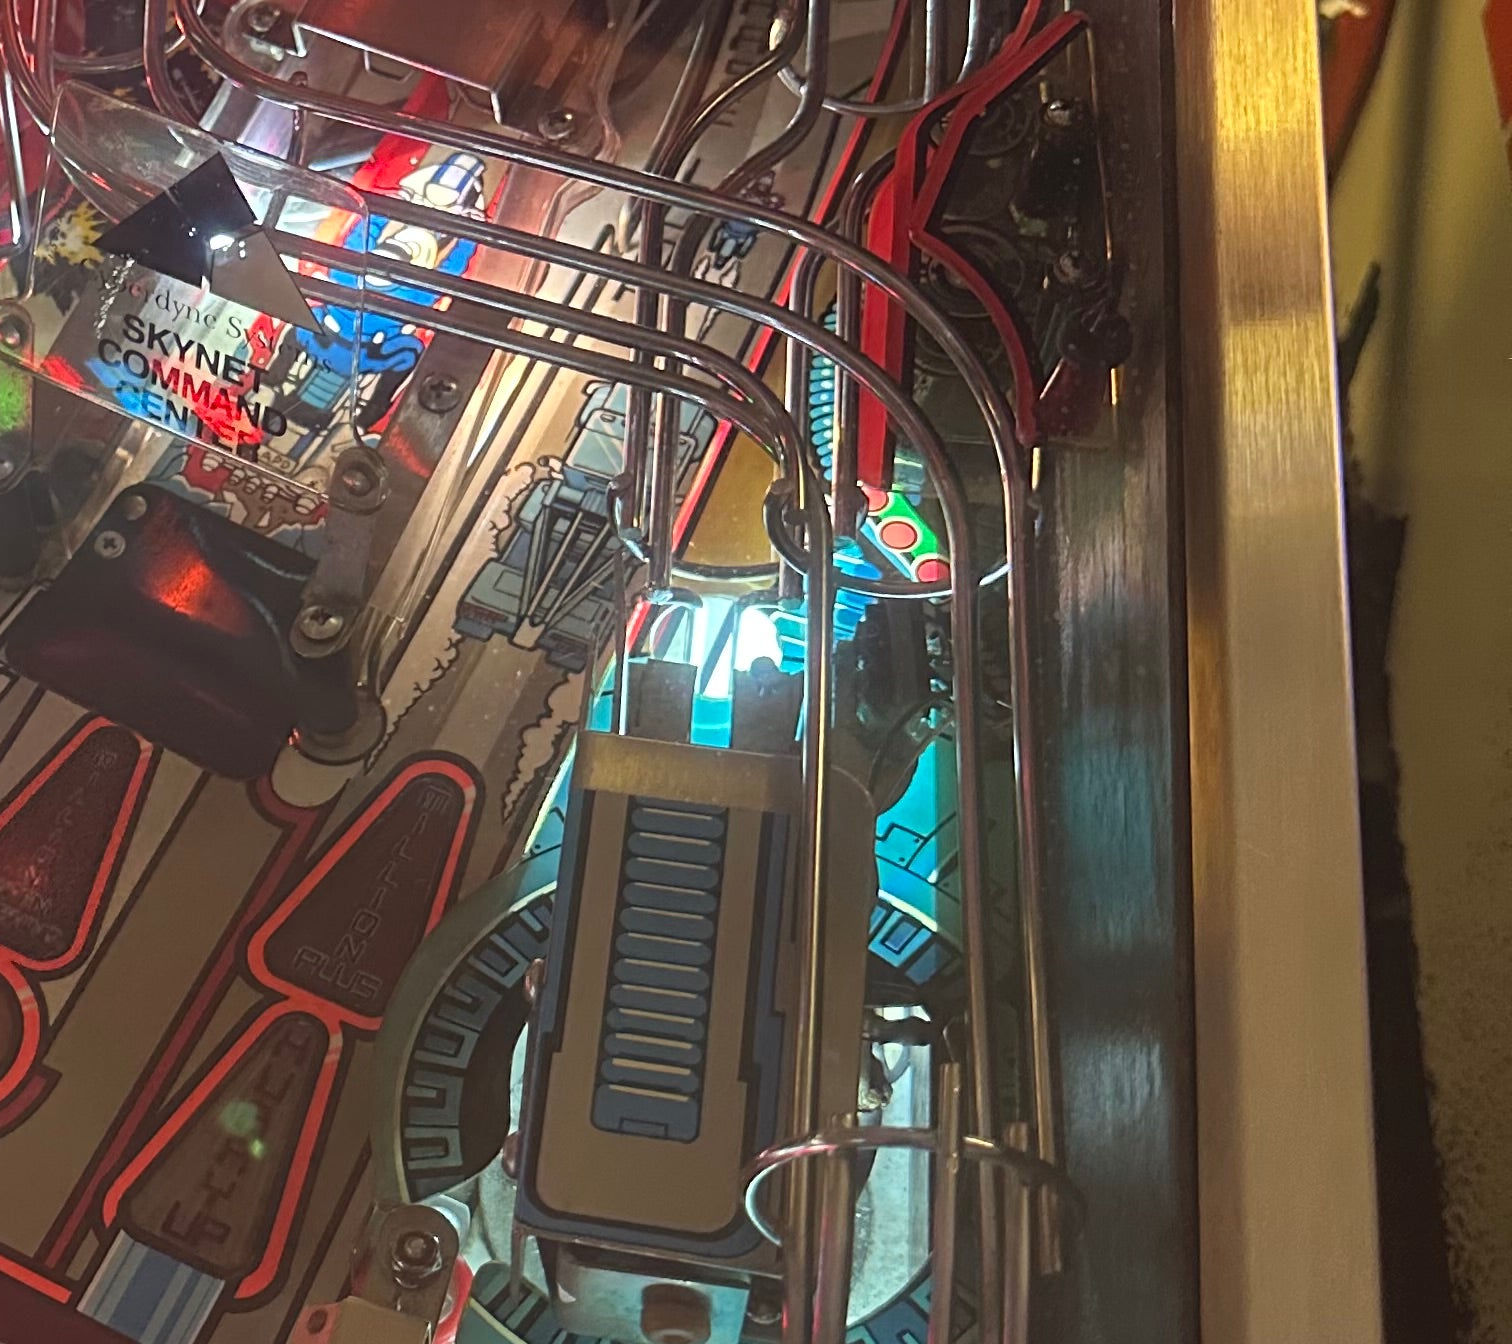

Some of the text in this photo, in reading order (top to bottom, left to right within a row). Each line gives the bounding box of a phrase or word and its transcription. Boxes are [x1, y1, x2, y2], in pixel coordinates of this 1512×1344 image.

[97, 337, 288, 437] COMMAND
[122, 313, 270, 394] SKYNET
[116, 380, 261, 463] CENTER
[294, 784, 453, 1000] MILLION PLUS
[160, 1201, 231, 1251] UP
